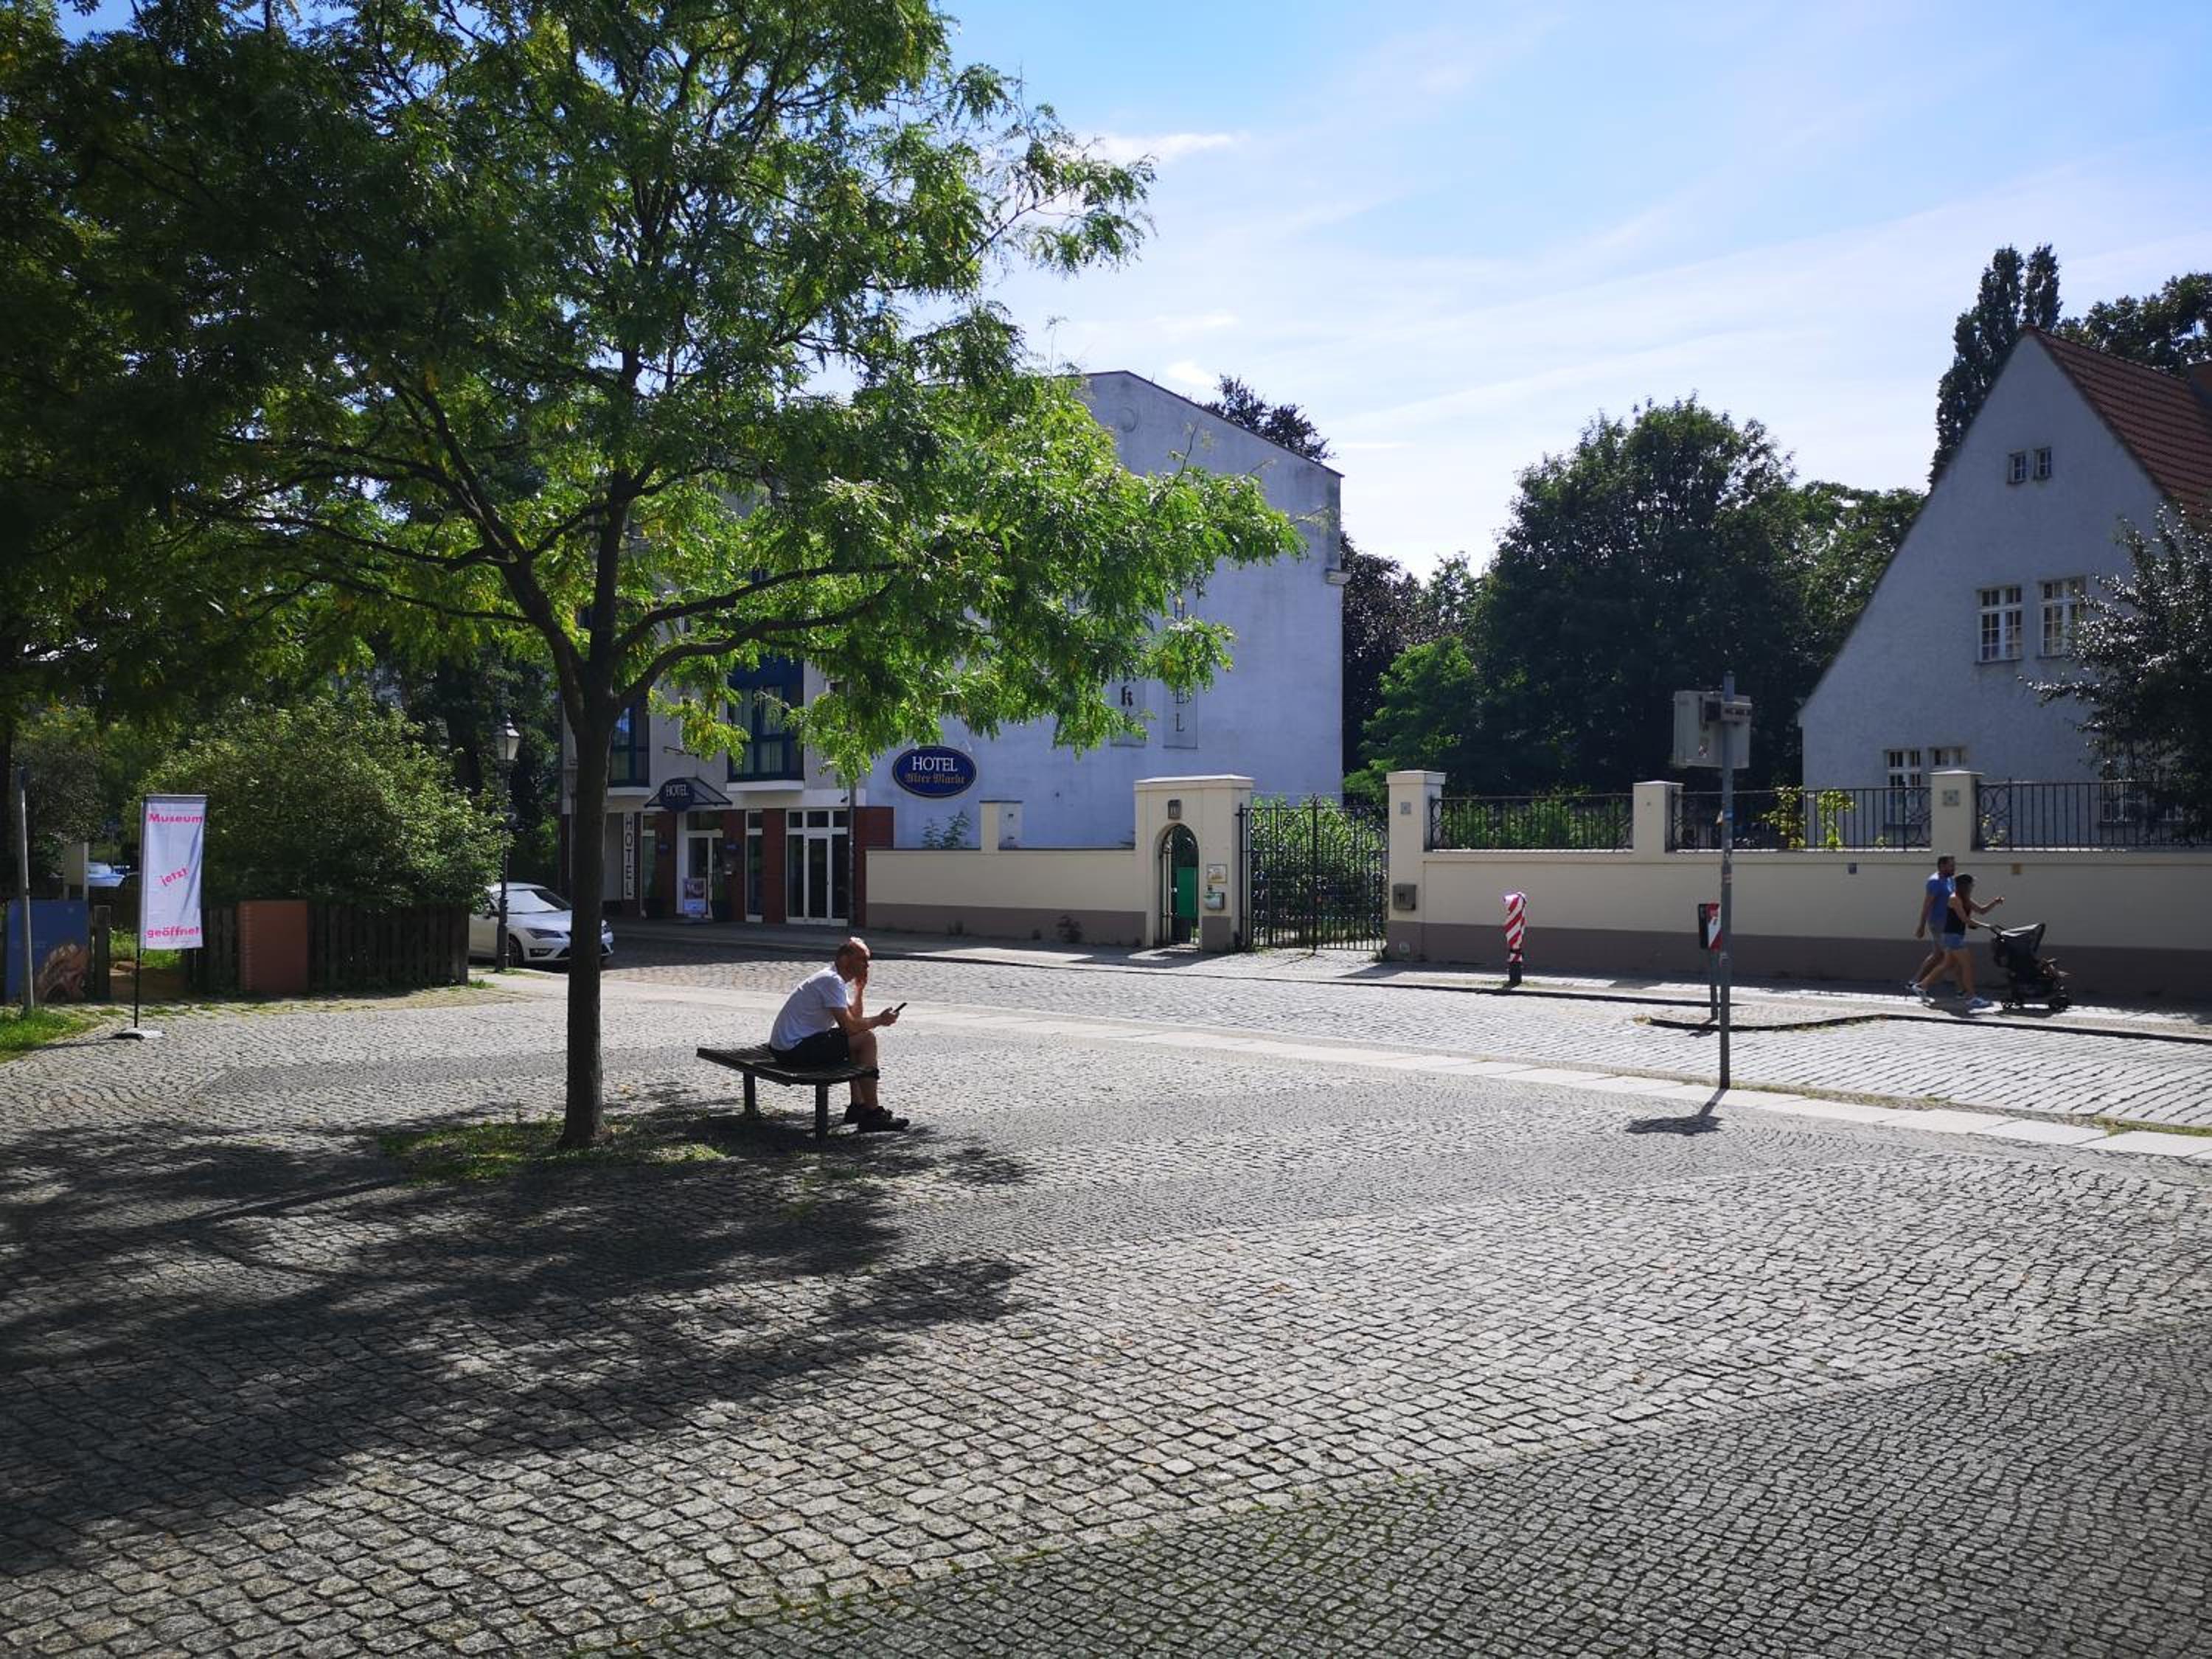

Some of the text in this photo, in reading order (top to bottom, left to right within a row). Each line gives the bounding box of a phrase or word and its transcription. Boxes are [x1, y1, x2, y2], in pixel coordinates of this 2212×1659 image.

[1175, 602, 1186, 731] HEL
[911, 756, 958, 772] HOTEL
[666, 784, 689, 797] HOTEL
[147, 813, 203, 823] Museum
[625, 815, 633, 897] HOTEL
[160, 867, 189, 886] jetzt
[146, 925, 200, 939] geöffnet
